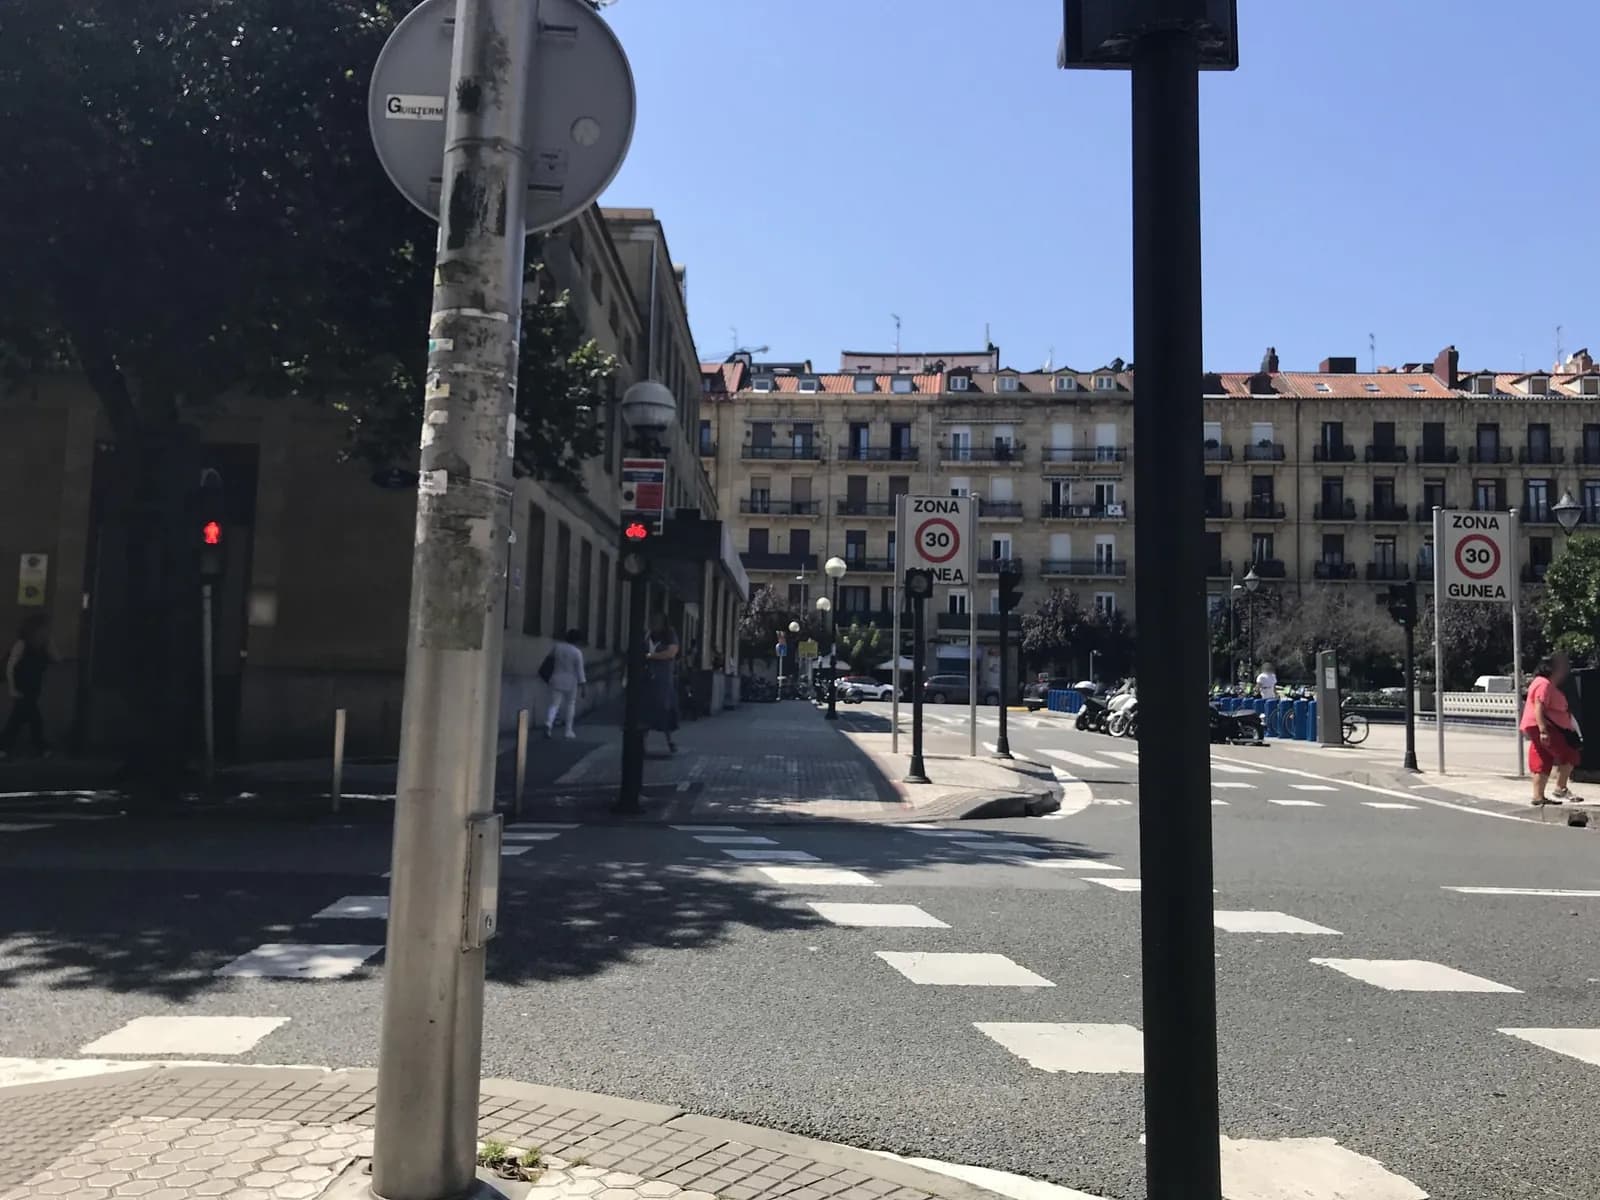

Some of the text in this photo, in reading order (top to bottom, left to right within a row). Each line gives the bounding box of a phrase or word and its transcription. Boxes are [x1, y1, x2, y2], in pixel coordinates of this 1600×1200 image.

[913, 500, 960, 514] ZONA
[1452, 515, 1500, 530] ZONA
[925, 532, 950, 547] 30
[1465, 548, 1490, 564] 30
[909, 567, 964, 582] NEA
[1448, 583, 1506, 599] GUNEA
